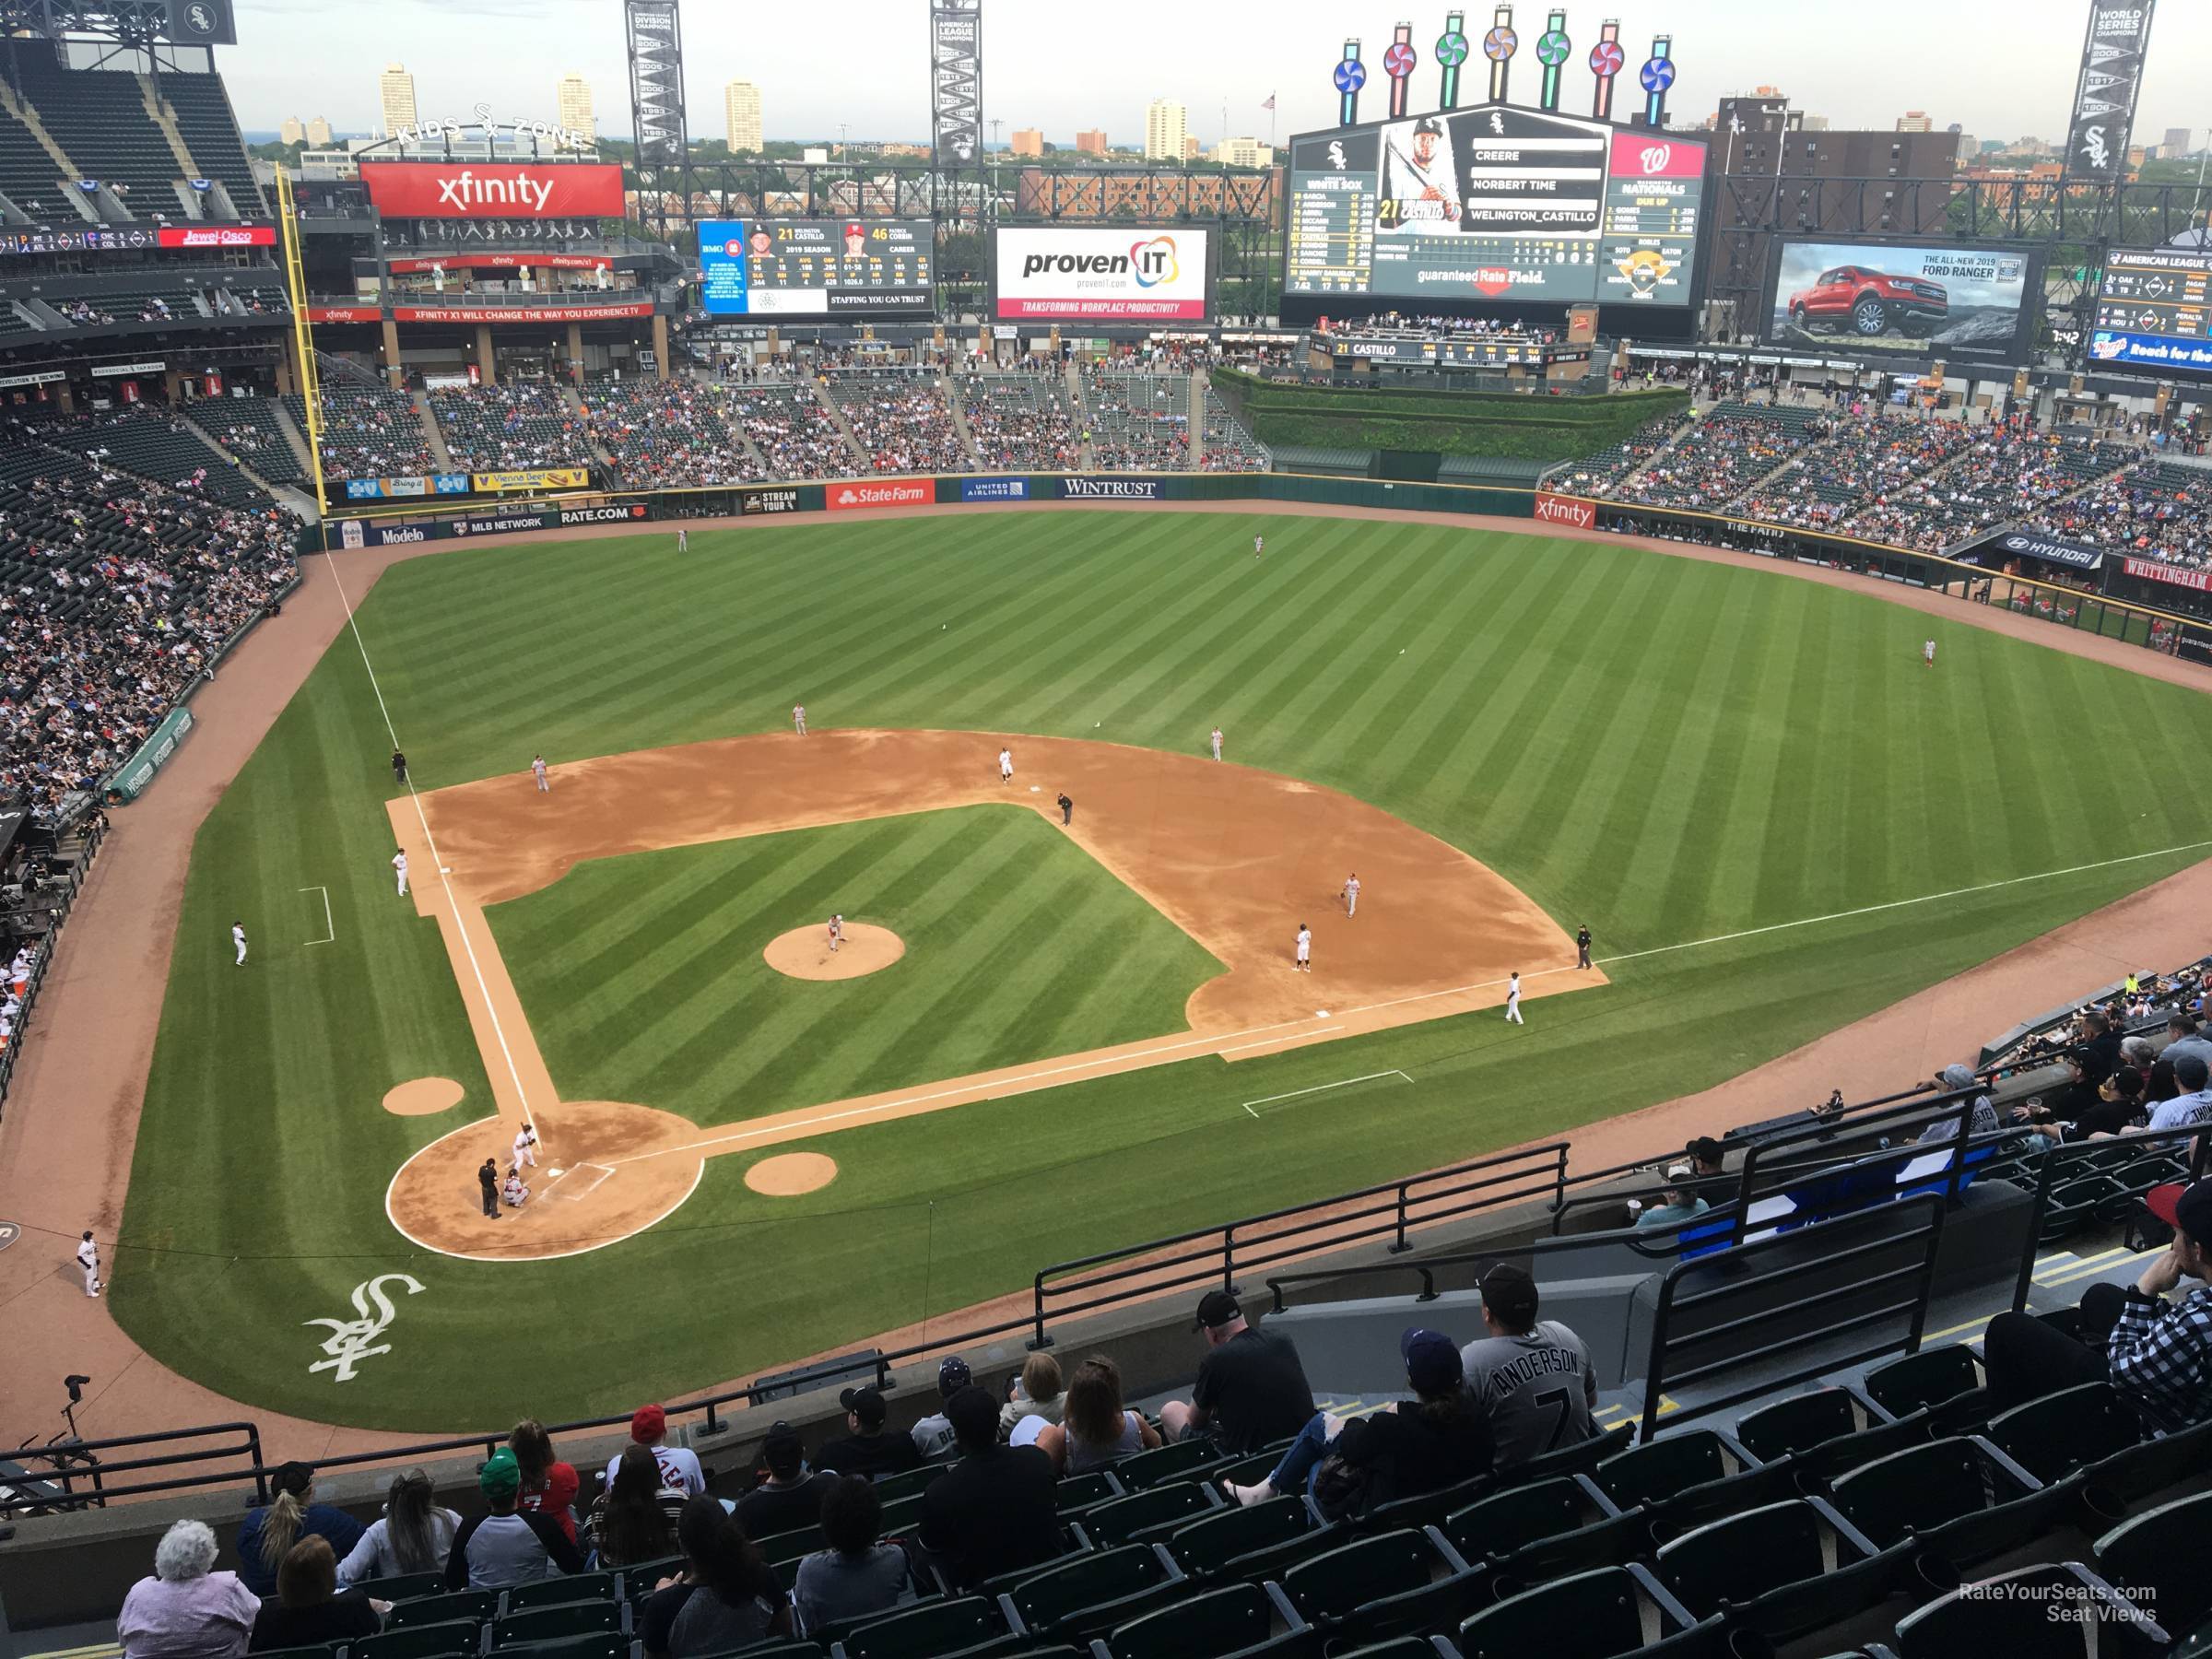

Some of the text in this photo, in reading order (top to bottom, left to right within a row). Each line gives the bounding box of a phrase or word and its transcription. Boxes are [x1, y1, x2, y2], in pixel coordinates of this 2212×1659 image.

[2100, 9, 2142, 20] WORLD
[2098, 19, 2139, 29] SERIES
[395, 117, 461, 146] KIDS
[512, 118, 584, 148] ZONE
[1475, 151, 1520, 161] CREERE
[437, 171, 554, 211] xfinity
[1341, 181, 1362, 190] SOX
[1473, 179, 1557, 191] NORBERT TIME
[1622, 184, 1686, 195] NATIONALS
[1637, 197, 1669, 206] DUE UP
[1379, 199, 1399, 218] 21
[1471, 210, 1596, 222] WELINGTON_CASTILLO
[184, 230, 253, 241] Jewel-Osco
[778, 228, 793, 240] 21
[872, 229, 888, 240] 46
[1556, 252, 1565, 264] 0
[1570, 252, 1580, 264] 0
[1585, 253, 1594, 264] 2
[1941, 256, 1974, 265] ALL-NEW
[2122, 256, 2206, 268] AMERICAN LEAGUE
[1023, 251, 1167, 278] proven IT
[1418, 270, 1478, 283] guaranteed
[1479, 270, 1506, 282] Rate
[1923, 265, 1994, 278] FORD RANGER
[1077, 279, 1126, 289] provenIT.com
[1022, 301, 1180, 313] TRANSFORMING WORKPLACE PRODUCTIVITY
[415, 311, 448, 319] XFINITY
[462, 311, 484, 320] WILL
[485, 311, 523, 320] CHANGE
[524, 311, 542, 319] THE
[543, 310, 562, 319] WAY
[564, 310, 582, 318] YOU
[583, 308, 629, 318] EXPERIENCE
[629, 307, 639, 315] TV
[2053, 330, 2079, 345] 7:42
[1337, 344, 1347, 354] 21
[1353, 345, 1396, 356] CASTILLO
[2130, 344, 2212, 363] Reach for the
[393, 479, 416, 488] Bring
[493, 473, 547, 483] Vienna Beef
[1065, 479, 1156, 495] WINTRUST
[763, 491, 796, 501] STREAM
[763, 501, 785, 511] YOUR
[561, 508, 629, 524] RATE.COM
[1537, 498, 1592, 527] xfinity
[472, 518, 542, 532] MLB NETWORK
[382, 528, 424, 545] Modelo
[2030, 543, 2093, 563] HYUNDAI
[2128, 559, 2207, 590] WHITTINGHAM
[1491, 1348, 1580, 1397] ANDERSON
[1534, 1386, 1572, 1455] 7
